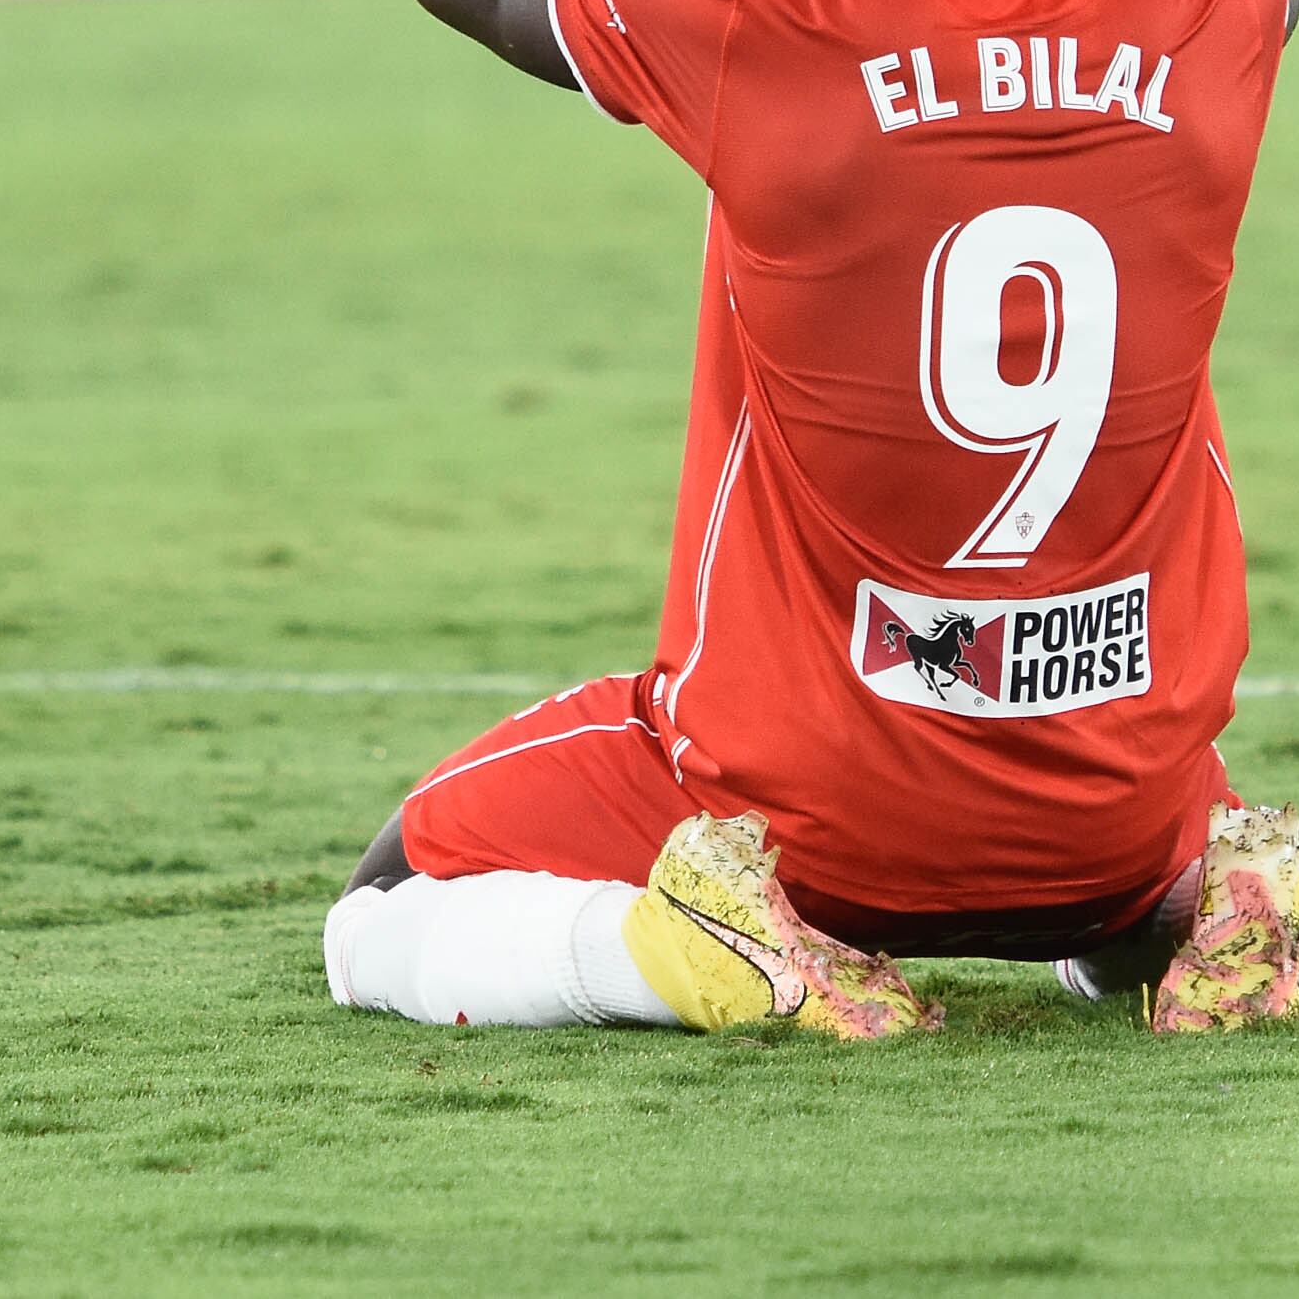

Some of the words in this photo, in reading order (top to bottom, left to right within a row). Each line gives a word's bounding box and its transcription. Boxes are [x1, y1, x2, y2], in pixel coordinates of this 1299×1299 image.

[860, 46, 958, 133] EL
[977, 36, 1175, 134] BILAL
[918, 204, 1119, 569] 9
[1012, 587, 1145, 655] POWER
[1009, 635, 1145, 703] HORSE
